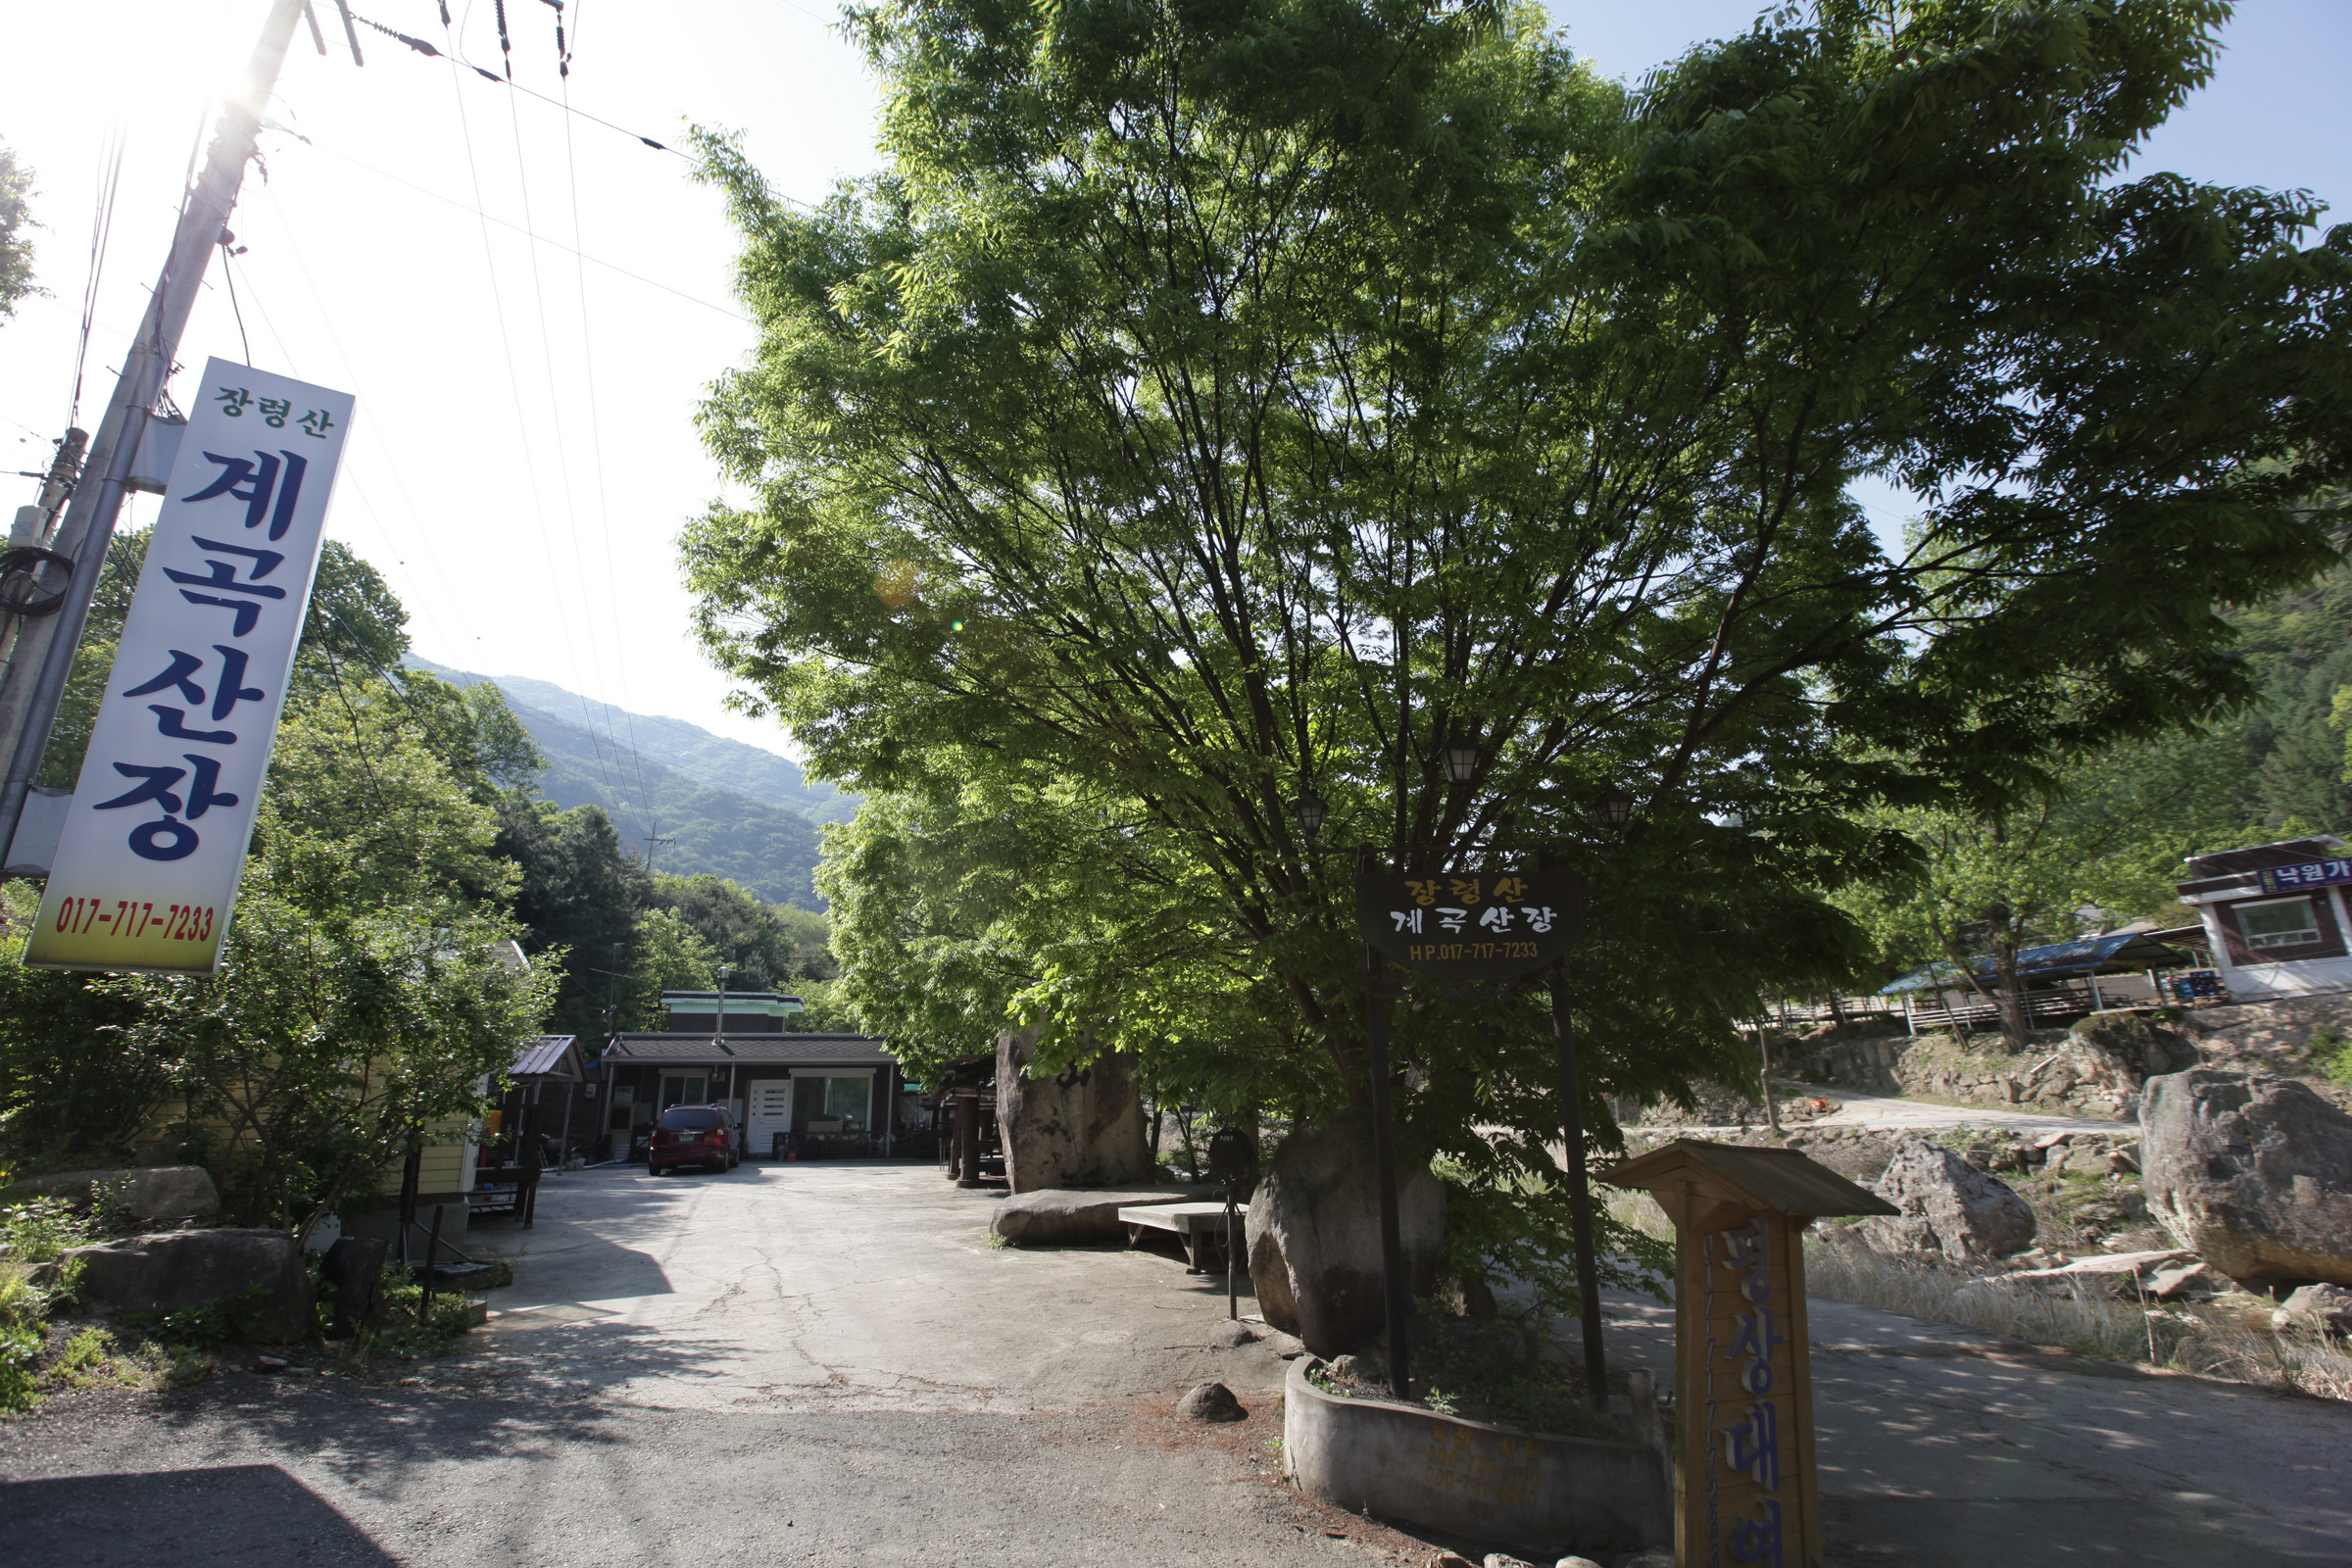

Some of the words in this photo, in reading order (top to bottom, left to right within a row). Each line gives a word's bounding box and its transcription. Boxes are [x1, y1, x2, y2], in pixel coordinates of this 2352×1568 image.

[213, 386, 335, 439] 장령산
[92, 449, 308, 862] 계곡산장
[2276, 859, 2352, 884] 낙원가
[1404, 877, 1529, 906] 장령산
[56, 896, 214, 943] 017-717-7233
[1390, 906, 1558, 934] 계곡산장
